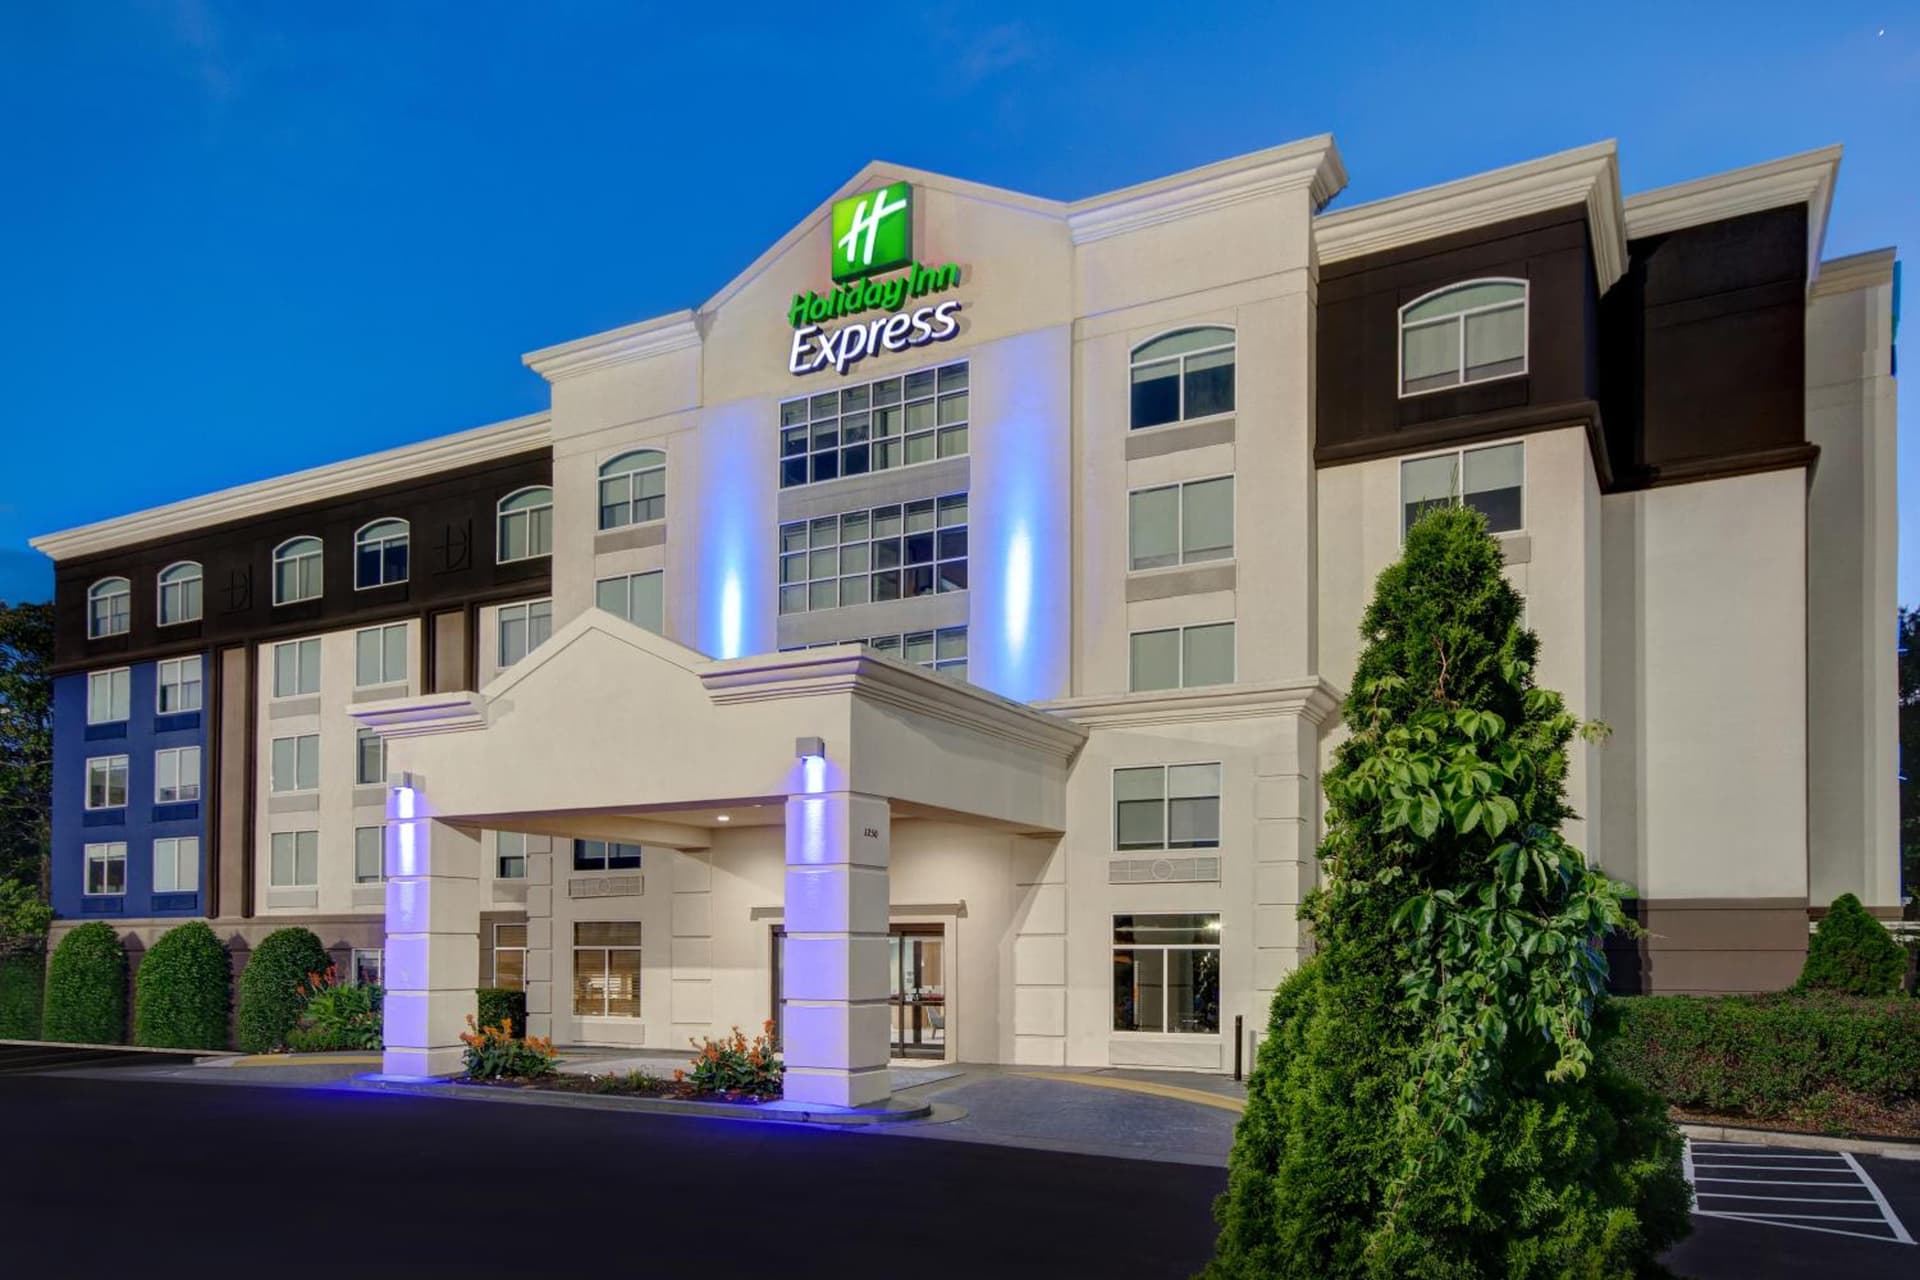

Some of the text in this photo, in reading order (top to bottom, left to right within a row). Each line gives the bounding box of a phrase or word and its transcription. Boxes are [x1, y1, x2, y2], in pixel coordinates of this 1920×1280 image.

[838, 189, 907, 265] H
[788, 261, 961, 326] Holiday Inn
[789, 301, 962, 374] Express
